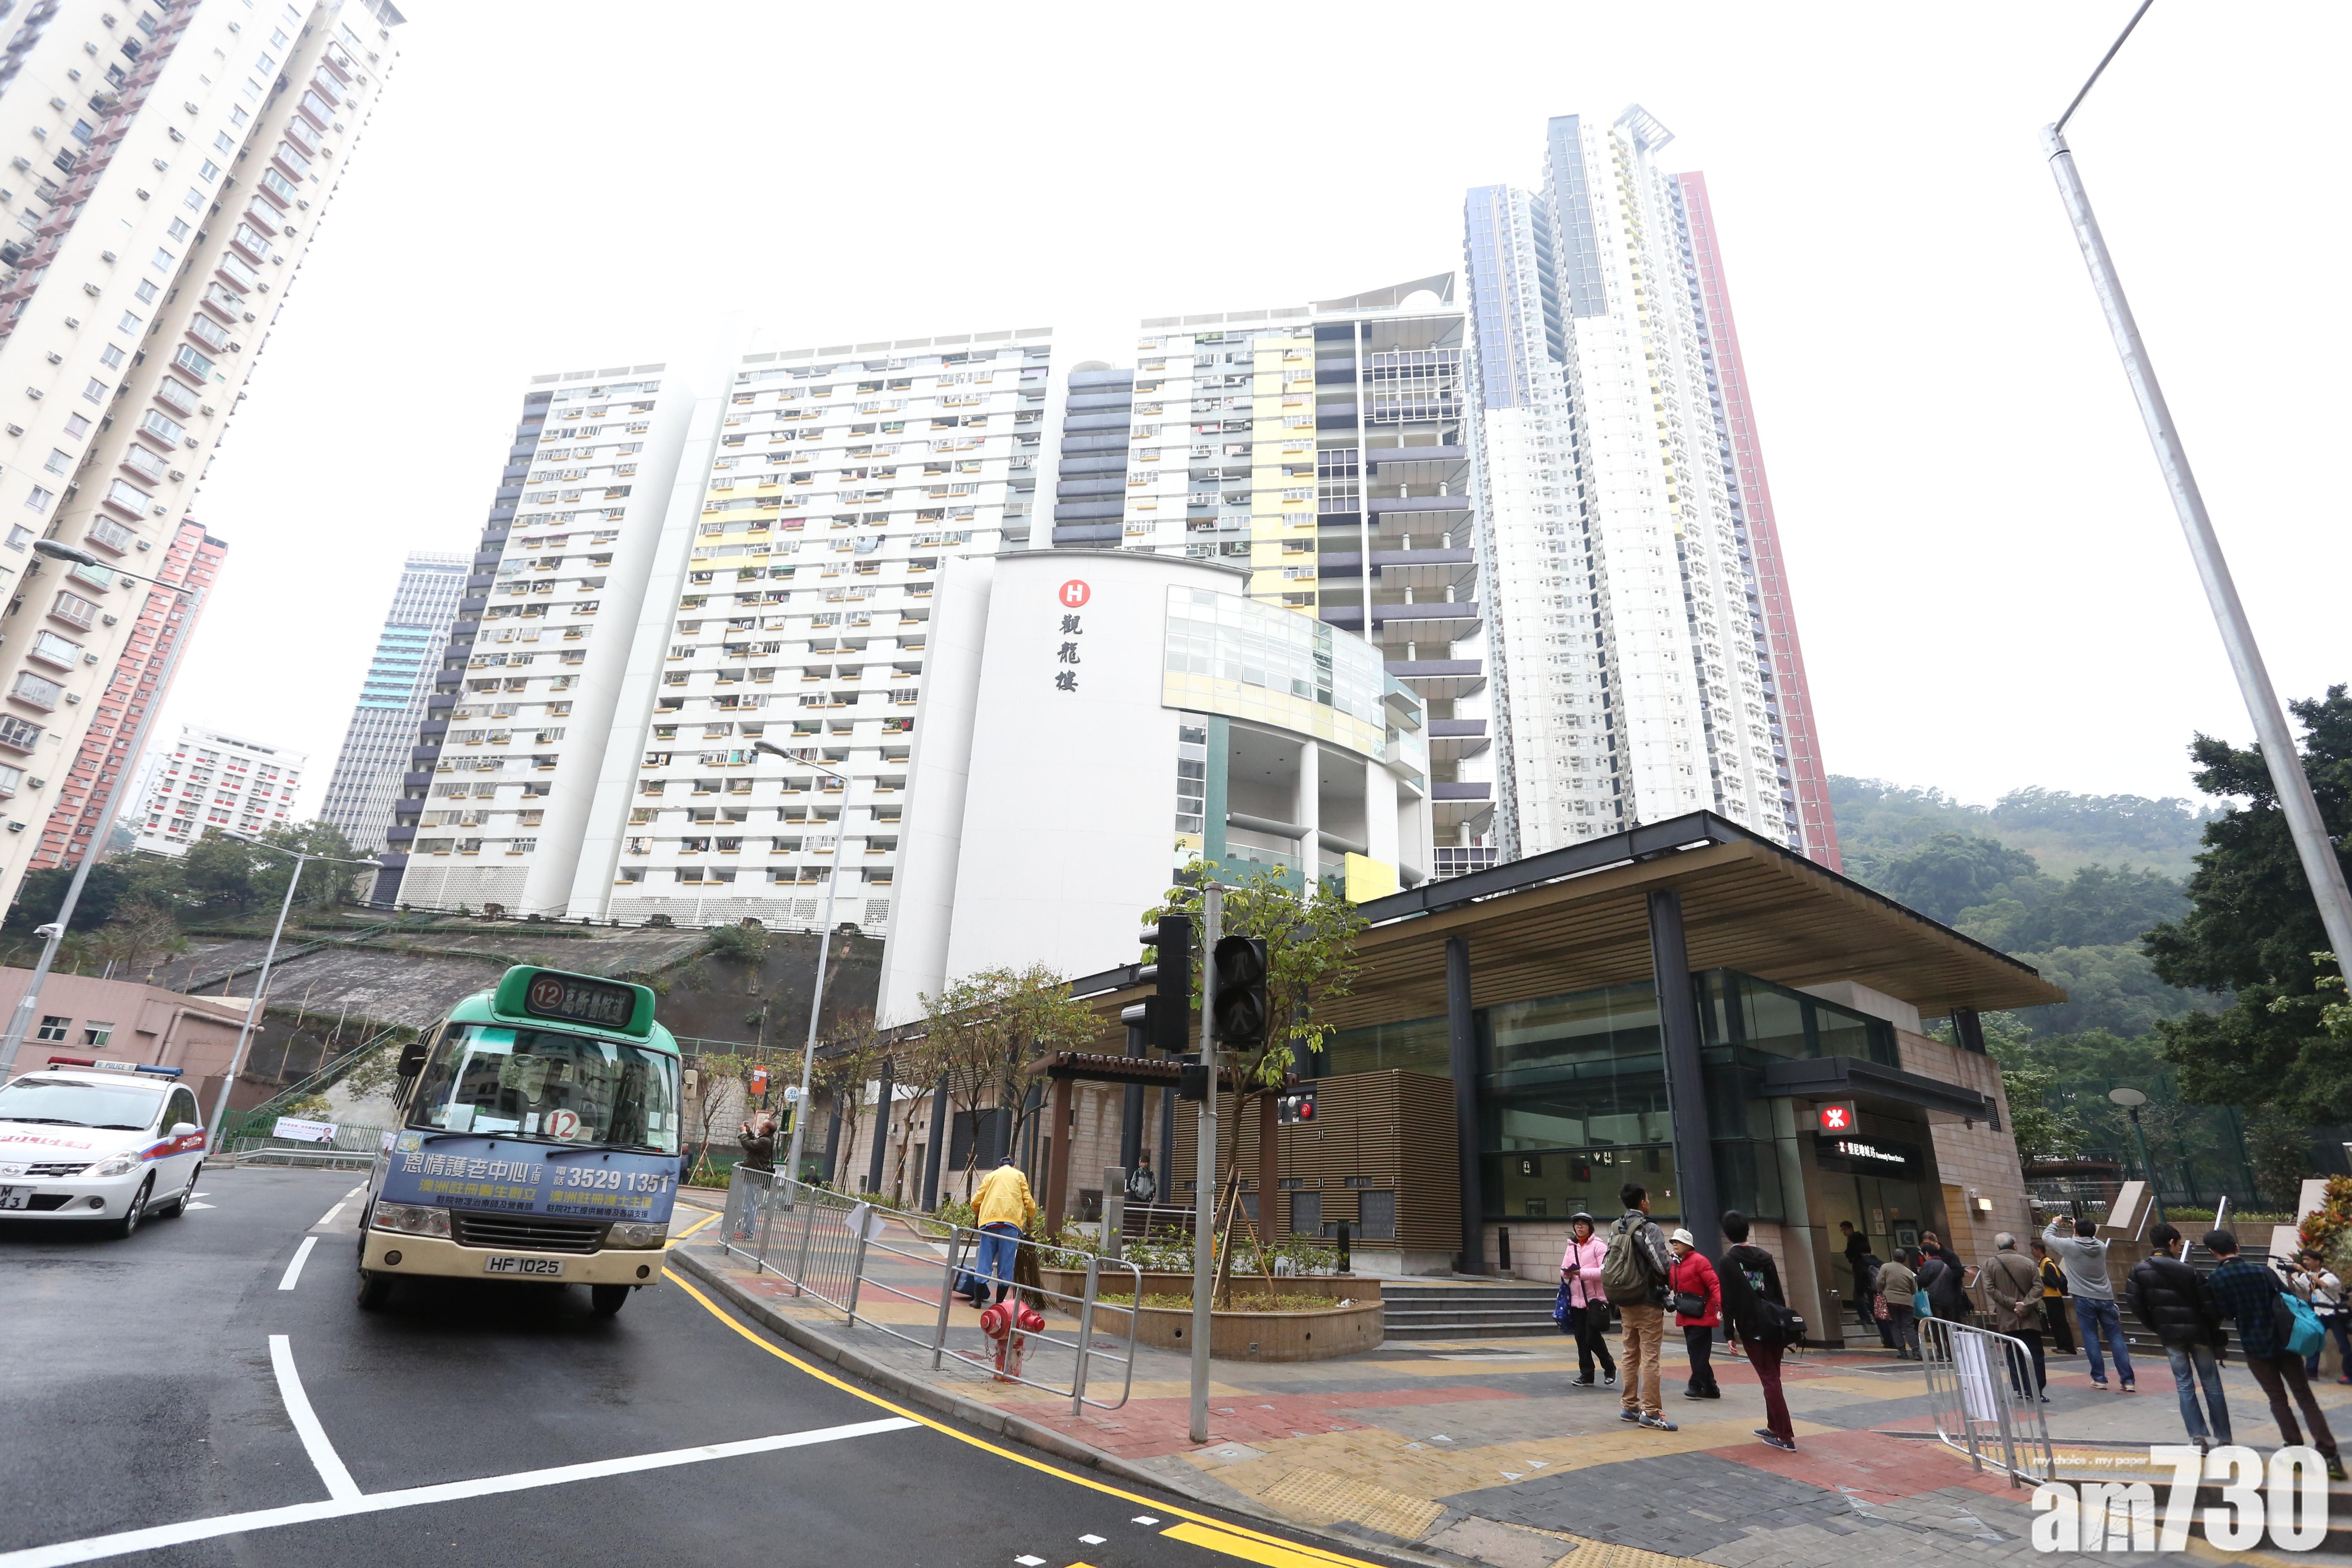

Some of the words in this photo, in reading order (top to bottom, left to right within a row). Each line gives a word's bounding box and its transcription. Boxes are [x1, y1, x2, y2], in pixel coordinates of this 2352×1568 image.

[1055, 614, 1083, 692] 觀龍樓
[538, 984, 559, 1004] 12
[549, 1112, 577, 1138] 12
[1848, 1143, 1875, 1158] 堅尼地城站
[1876, 1152, 1888, 1161] Kennedy
[402, 1154, 530, 1183] 恩情護老中心
[419, 1179, 537, 1200] 澳洲註冊醫生創立
[553, 1166, 567, 1185] 電話
[568, 1167, 621, 1190] 3529
[627, 1173, 669, 1193] 1351
[436, 1195, 534, 1211] 駐院物理治療師及營養師
[549, 1189, 653, 1208] 澳洲註冊護士主理
[490, 1257, 514, 1271] HF
[519, 1259, 559, 1273] 1025
